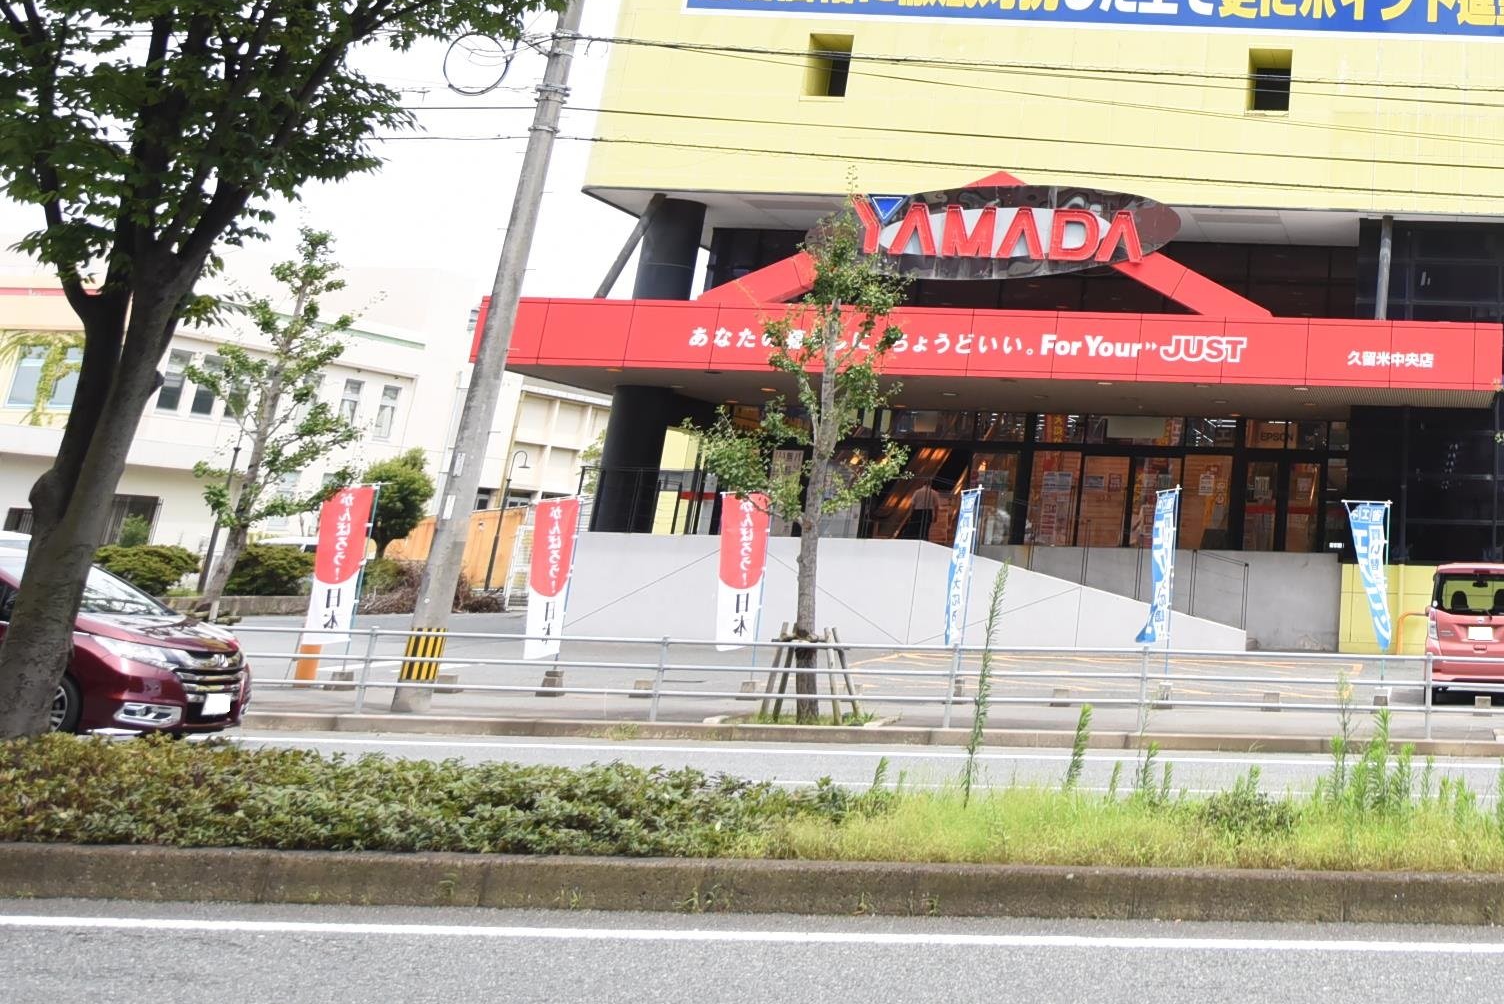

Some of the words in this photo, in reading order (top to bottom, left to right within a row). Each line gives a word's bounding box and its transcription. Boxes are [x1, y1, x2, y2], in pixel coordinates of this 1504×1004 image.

[851, 193, 1143, 263] YAMADA
[1040, 334, 1082, 356] For
[1087, 335, 1141, 359] Your
[1160, 335, 1248, 363] JUST
[1347, 350, 1434, 369] 久留米中央店
